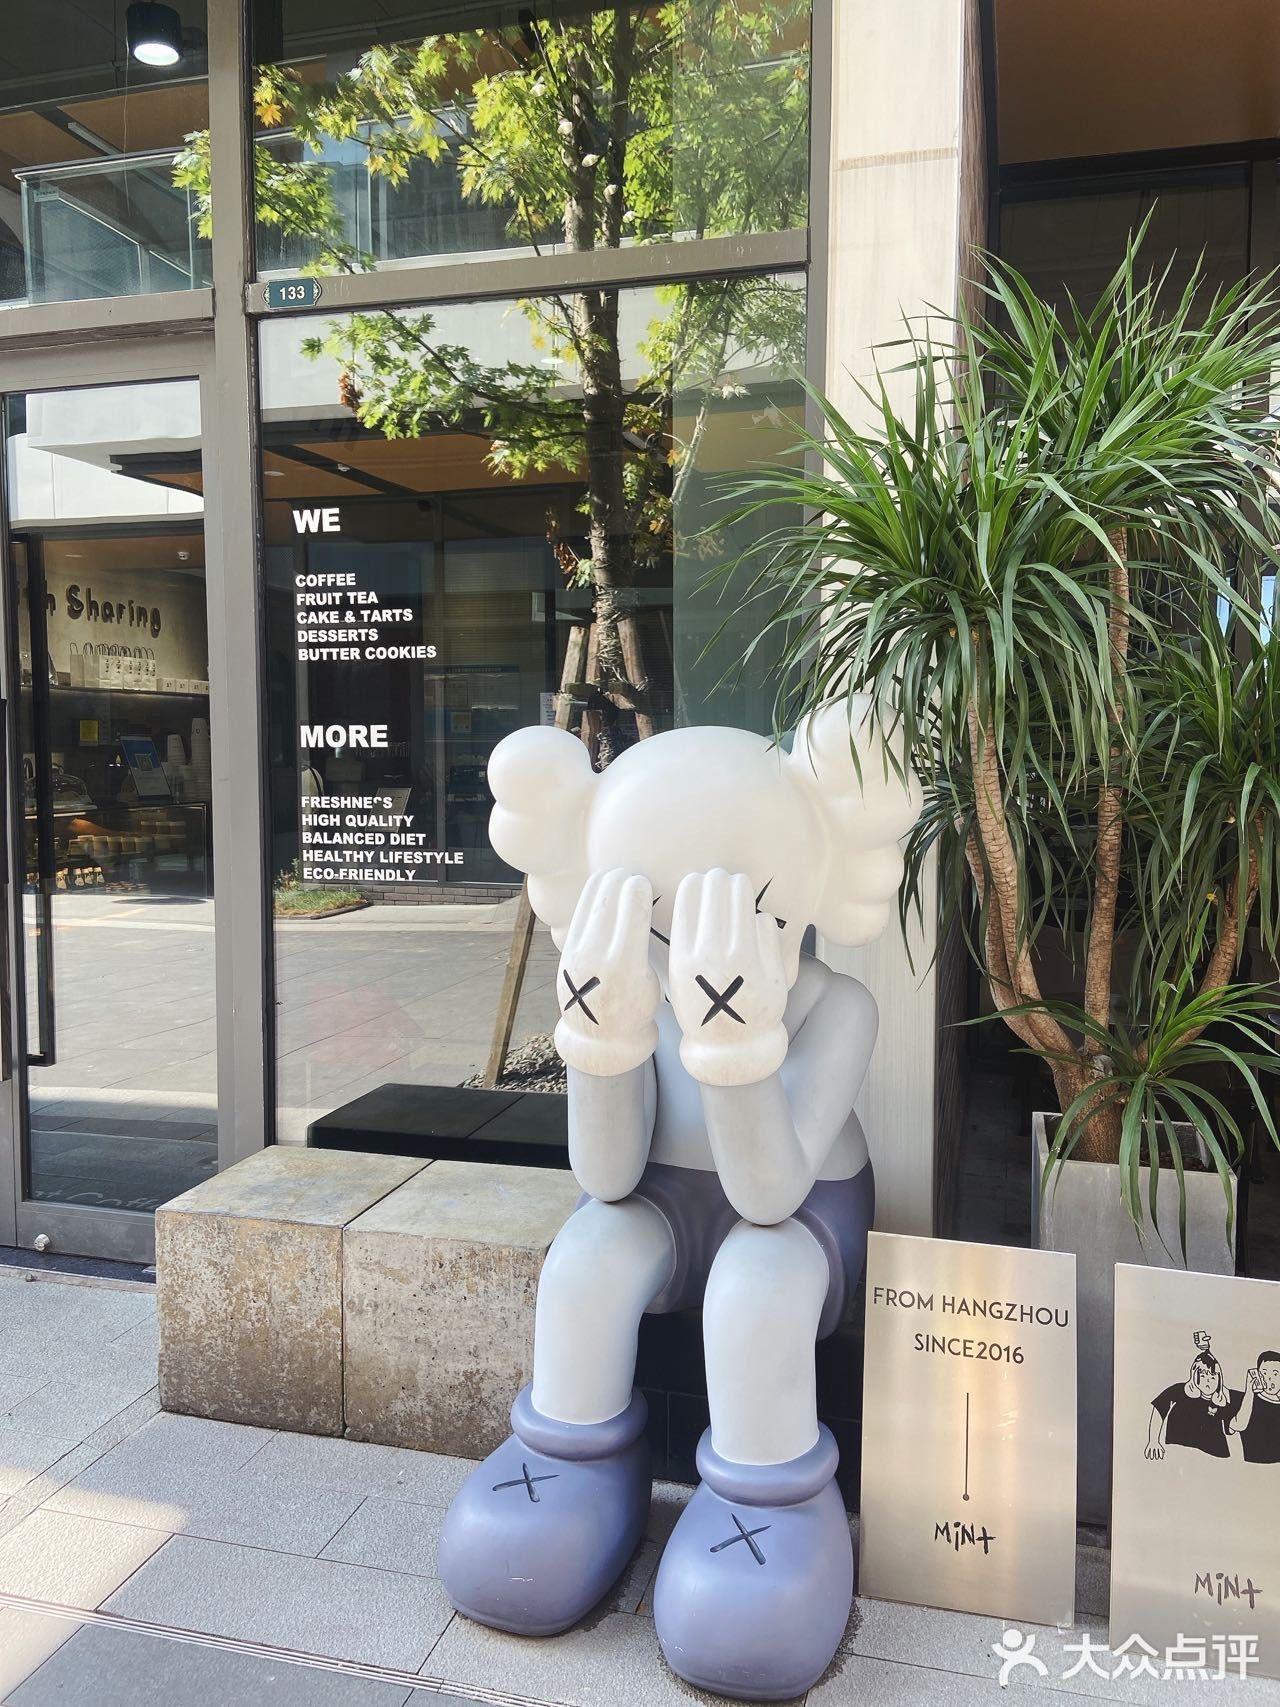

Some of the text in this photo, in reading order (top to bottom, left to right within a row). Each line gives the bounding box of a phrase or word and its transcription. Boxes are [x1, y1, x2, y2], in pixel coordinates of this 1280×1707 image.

[279, 285, 305, 301] 133
[293, 507, 341, 533] WE
[296, 572, 357, 587] COFFEE
[297, 591, 379, 606] FRUIT TEA
[66, 584, 162, 638] Sharing
[297, 608, 414, 625] CAKE & TARTS
[298, 628, 379, 643] DESSERTS
[299, 645, 437, 661] BUTTER COOKIES
[300, 724, 389, 748] MORE
[302, 813, 415, 828] HIGH QUALITY
[303, 831, 427, 846] BALANCED DIET
[303, 849, 465, 865] HEALTHY LIFESTYLE
[303, 867, 417, 882] ECO-FRIENDLY
[873, 1286, 1070, 1329] FROM HANGZHOU
[914, 1332, 1025, 1366] SINCE2016
